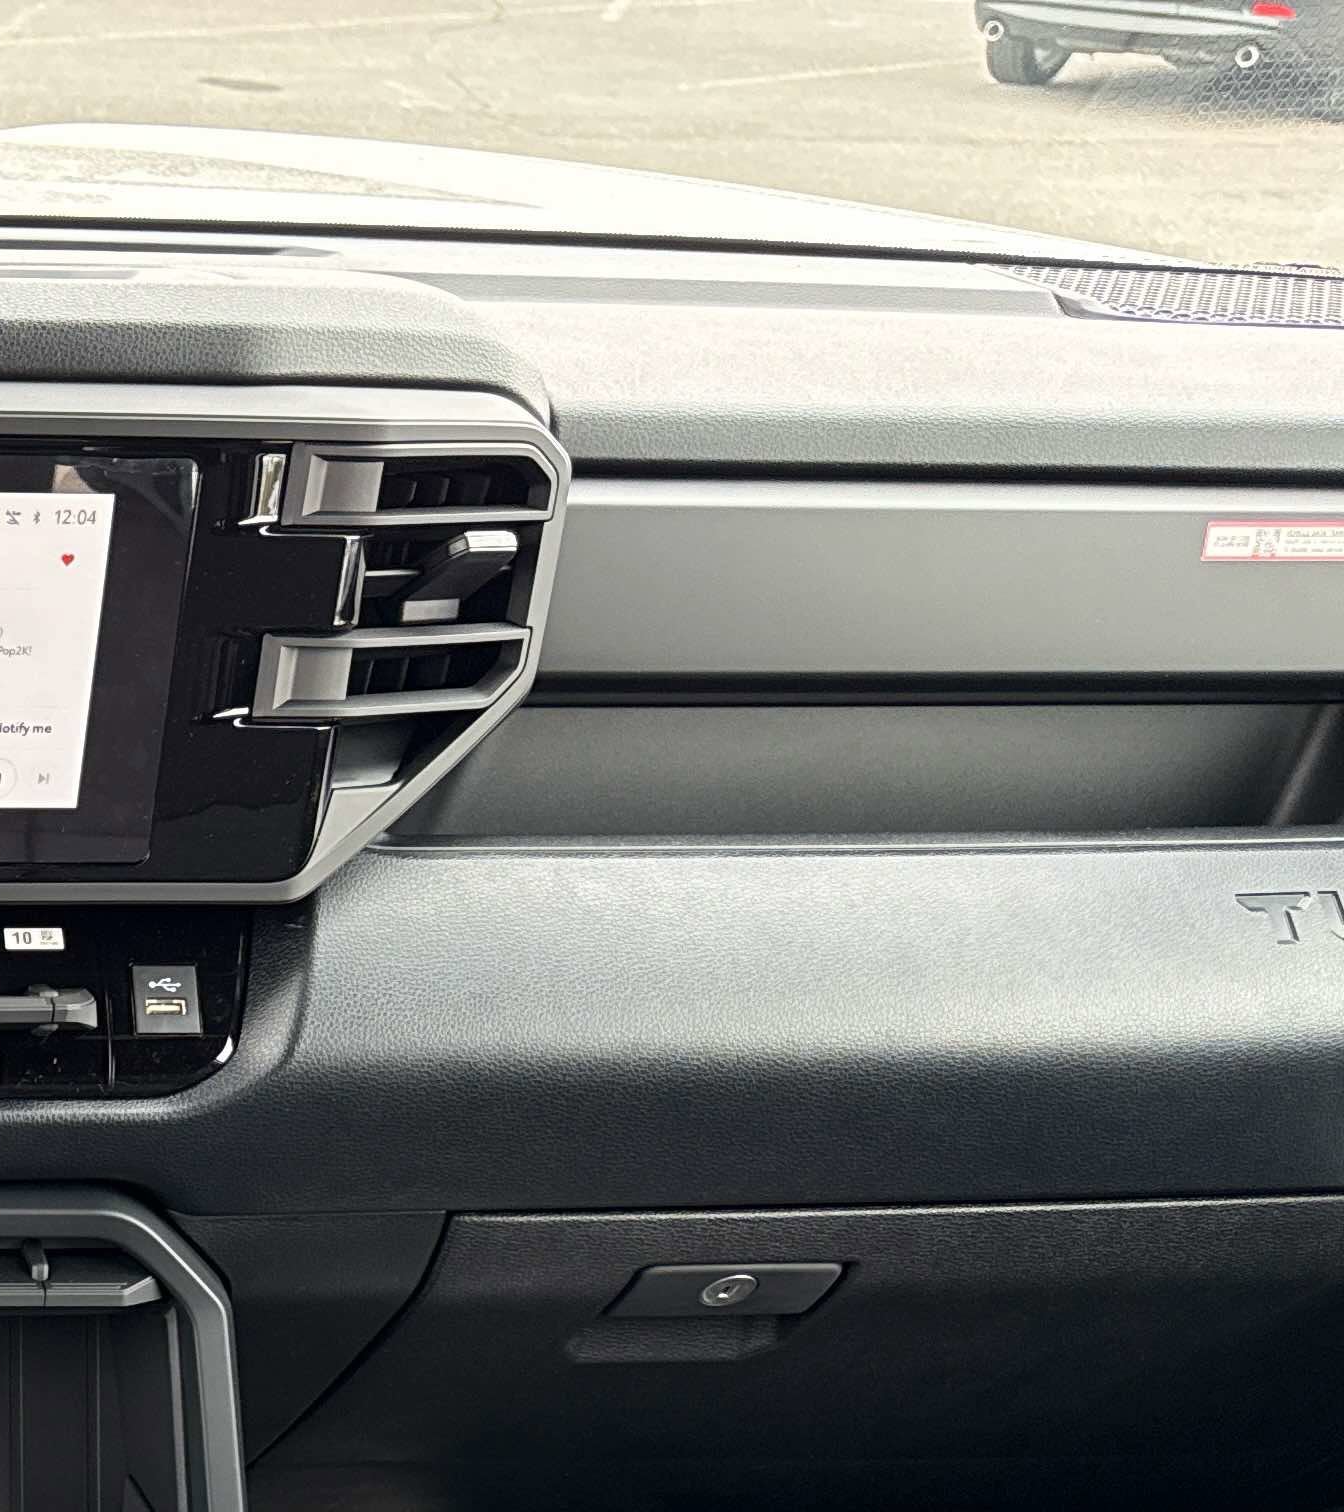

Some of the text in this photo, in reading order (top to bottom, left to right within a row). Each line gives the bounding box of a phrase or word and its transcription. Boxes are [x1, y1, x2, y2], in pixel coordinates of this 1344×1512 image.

[55, 509, 97, 525] 12:04
[33, 725, 52, 734] me
[12, 931, 32, 945] 10
